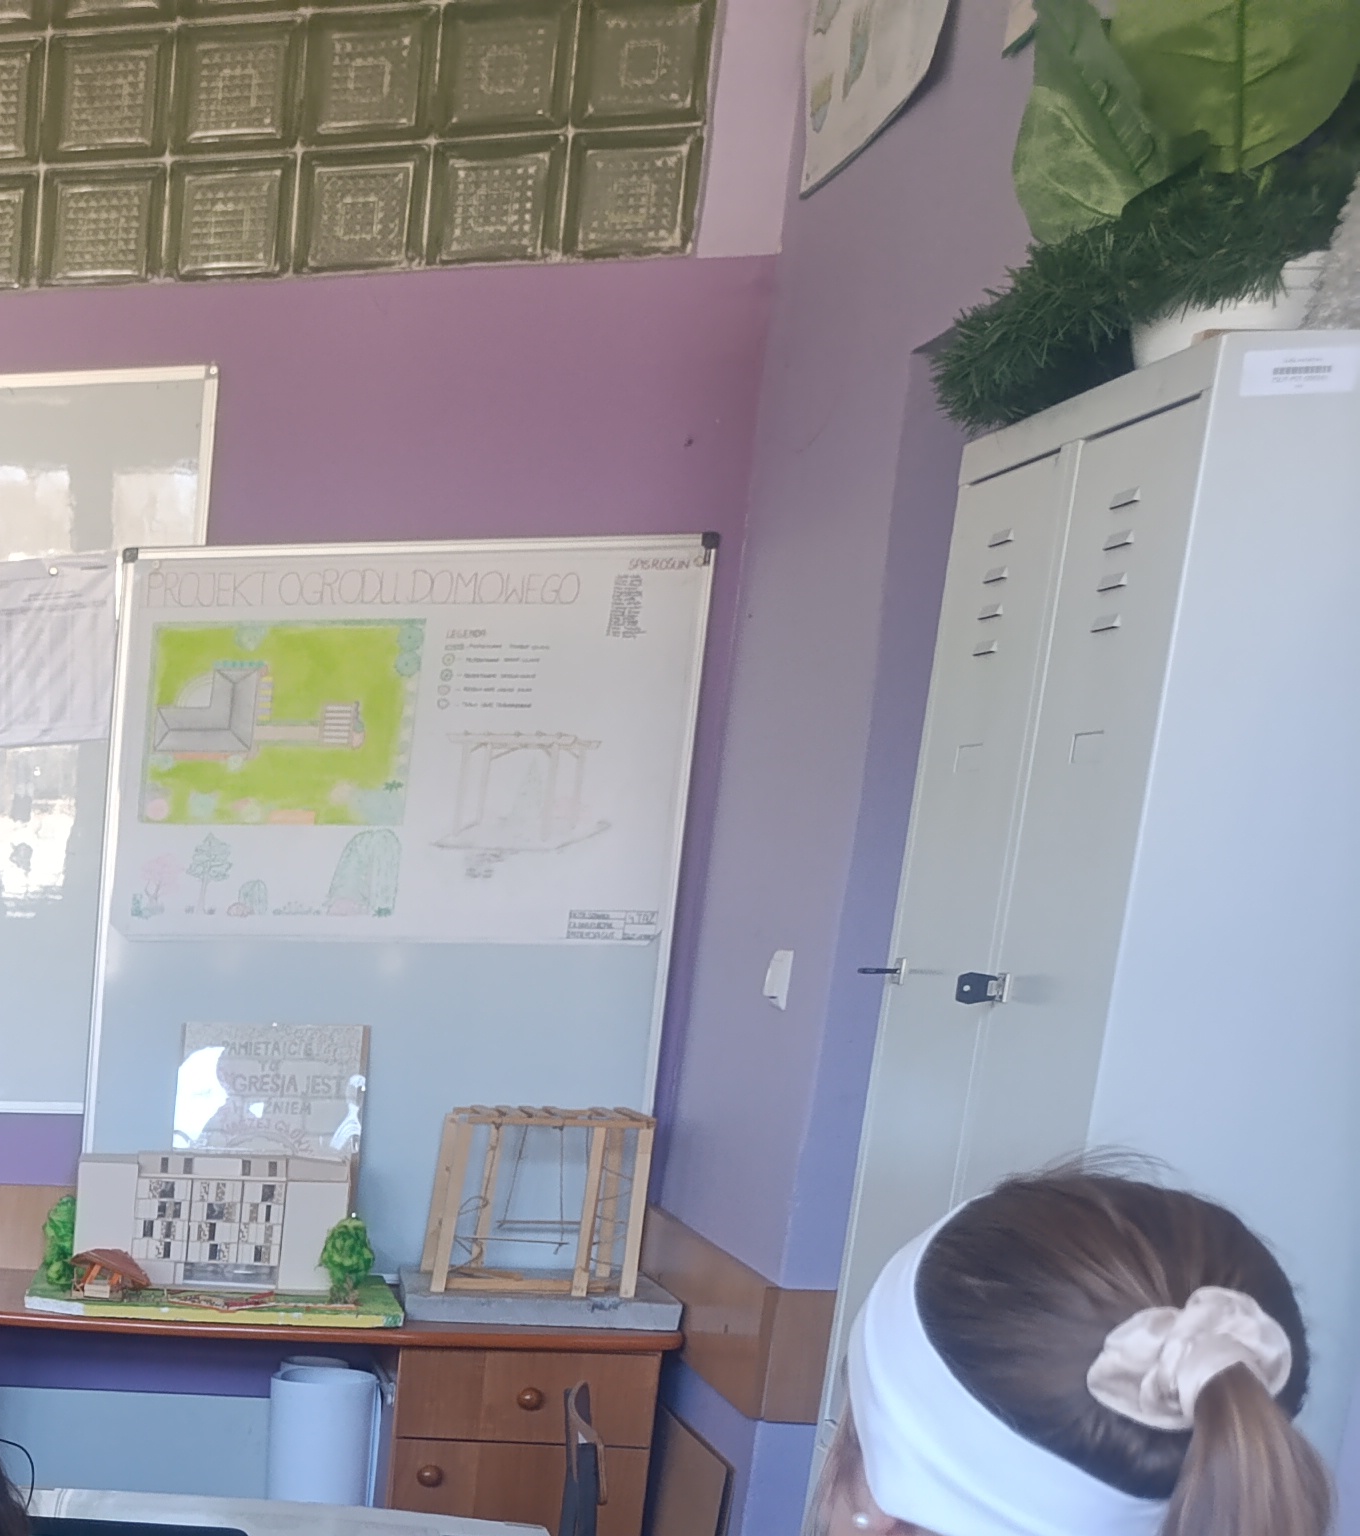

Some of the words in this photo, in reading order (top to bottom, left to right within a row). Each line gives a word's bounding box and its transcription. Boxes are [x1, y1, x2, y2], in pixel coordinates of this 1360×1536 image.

[144, 568, 272, 609] PROJEKT
[278, 567, 399, 607] OGRODU
[406, 568, 582, 607] DOMOWEGO
[301, 1074, 346, 1096] JEST
